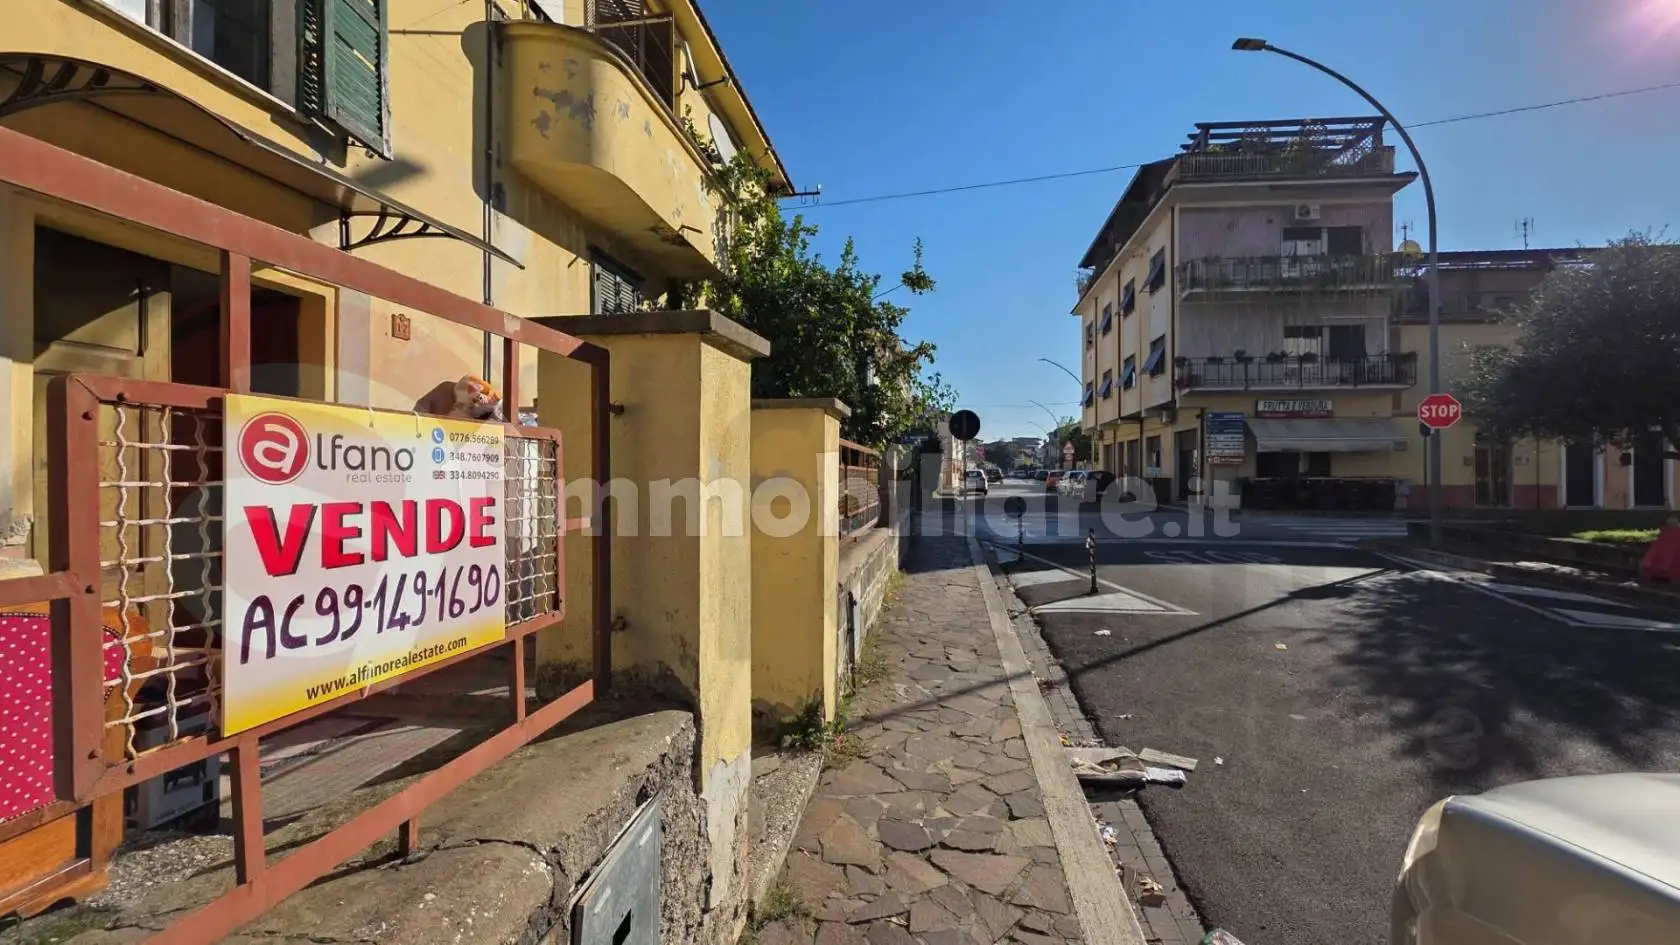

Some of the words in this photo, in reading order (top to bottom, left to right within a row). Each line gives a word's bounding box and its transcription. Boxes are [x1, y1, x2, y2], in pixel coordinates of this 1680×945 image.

[1421, 405, 1458, 418] STOP
[346, 471, 372, 483] real
[375, 472, 413, 484] estate
[243, 496, 497, 578] VENDE
